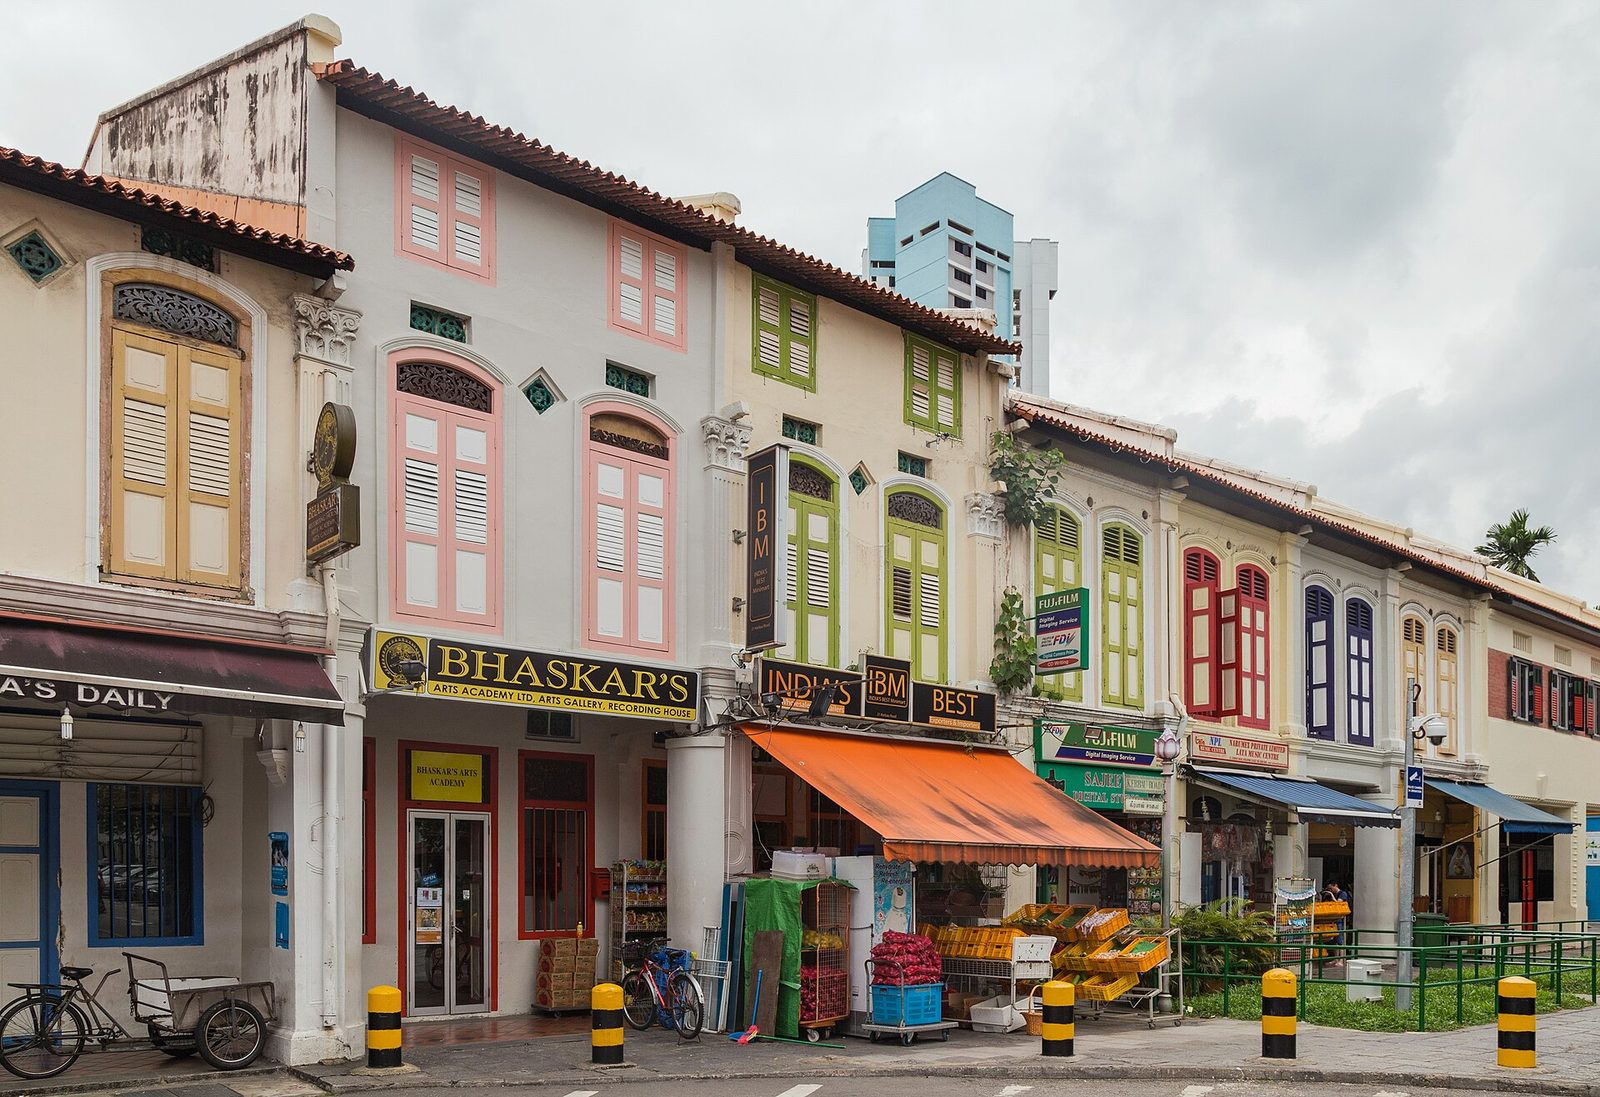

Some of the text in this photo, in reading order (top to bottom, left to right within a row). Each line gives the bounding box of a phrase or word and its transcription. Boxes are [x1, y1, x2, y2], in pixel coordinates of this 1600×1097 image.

[754, 482, 769, 560] IBM
[1039, 593, 1079, 609] FUJIFILM
[1039, 616, 1055, 624] Digital
[1039, 617, 1078, 629] Imaging Service
[437, 645, 689, 702] BHASKAR'S
[869, 669, 906, 698] IBM
[0, 677, 174, 710] A'S DAILY
[433, 684, 458, 694] ARTS
[461, 687, 514, 700] ACADEMY
[538, 695, 561, 705] ARTS
[608, 702, 661, 714] RECORDING
[663, 708, 691, 718] HOUSE
[933, 689, 978, 716] BEST
[1209, 736, 1222, 747] NPL
[1086, 751, 1136, 761] Digital Imaging Service
[416, 765, 478, 777] BHASKAR'S ARTS
[429, 778, 466, 788] ACADEMY
[1085, 771, 1122, 788] SAJEE
[1073, 790, 1109, 803] DIGITAL
